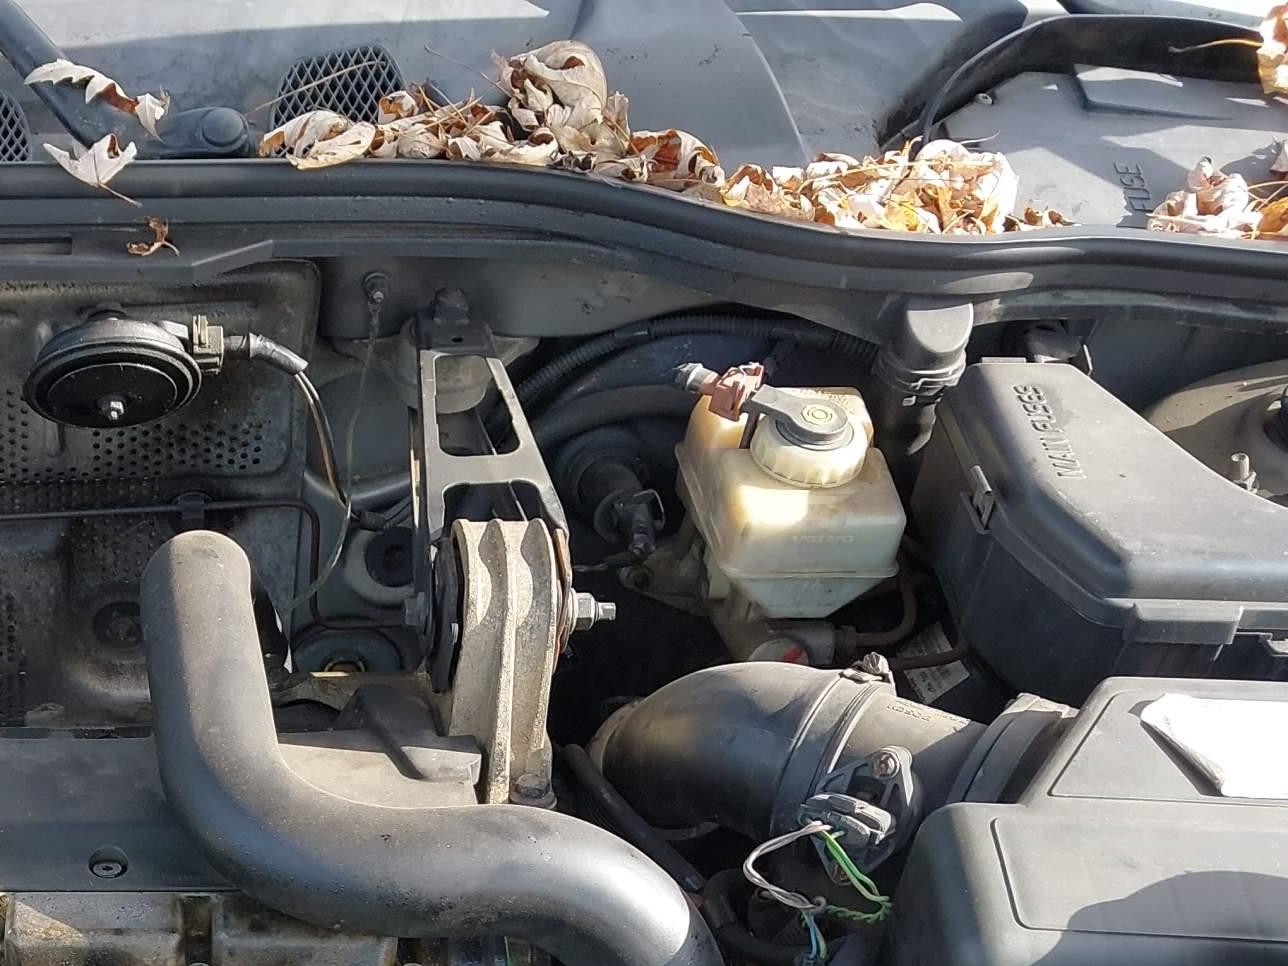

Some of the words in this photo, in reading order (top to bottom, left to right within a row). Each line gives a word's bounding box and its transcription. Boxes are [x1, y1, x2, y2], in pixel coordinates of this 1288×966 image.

[1112, 160, 1155, 213] FUSE
[1012, 384, 1065, 434] FUSES
[1038, 436, 1088, 480] MAIN
